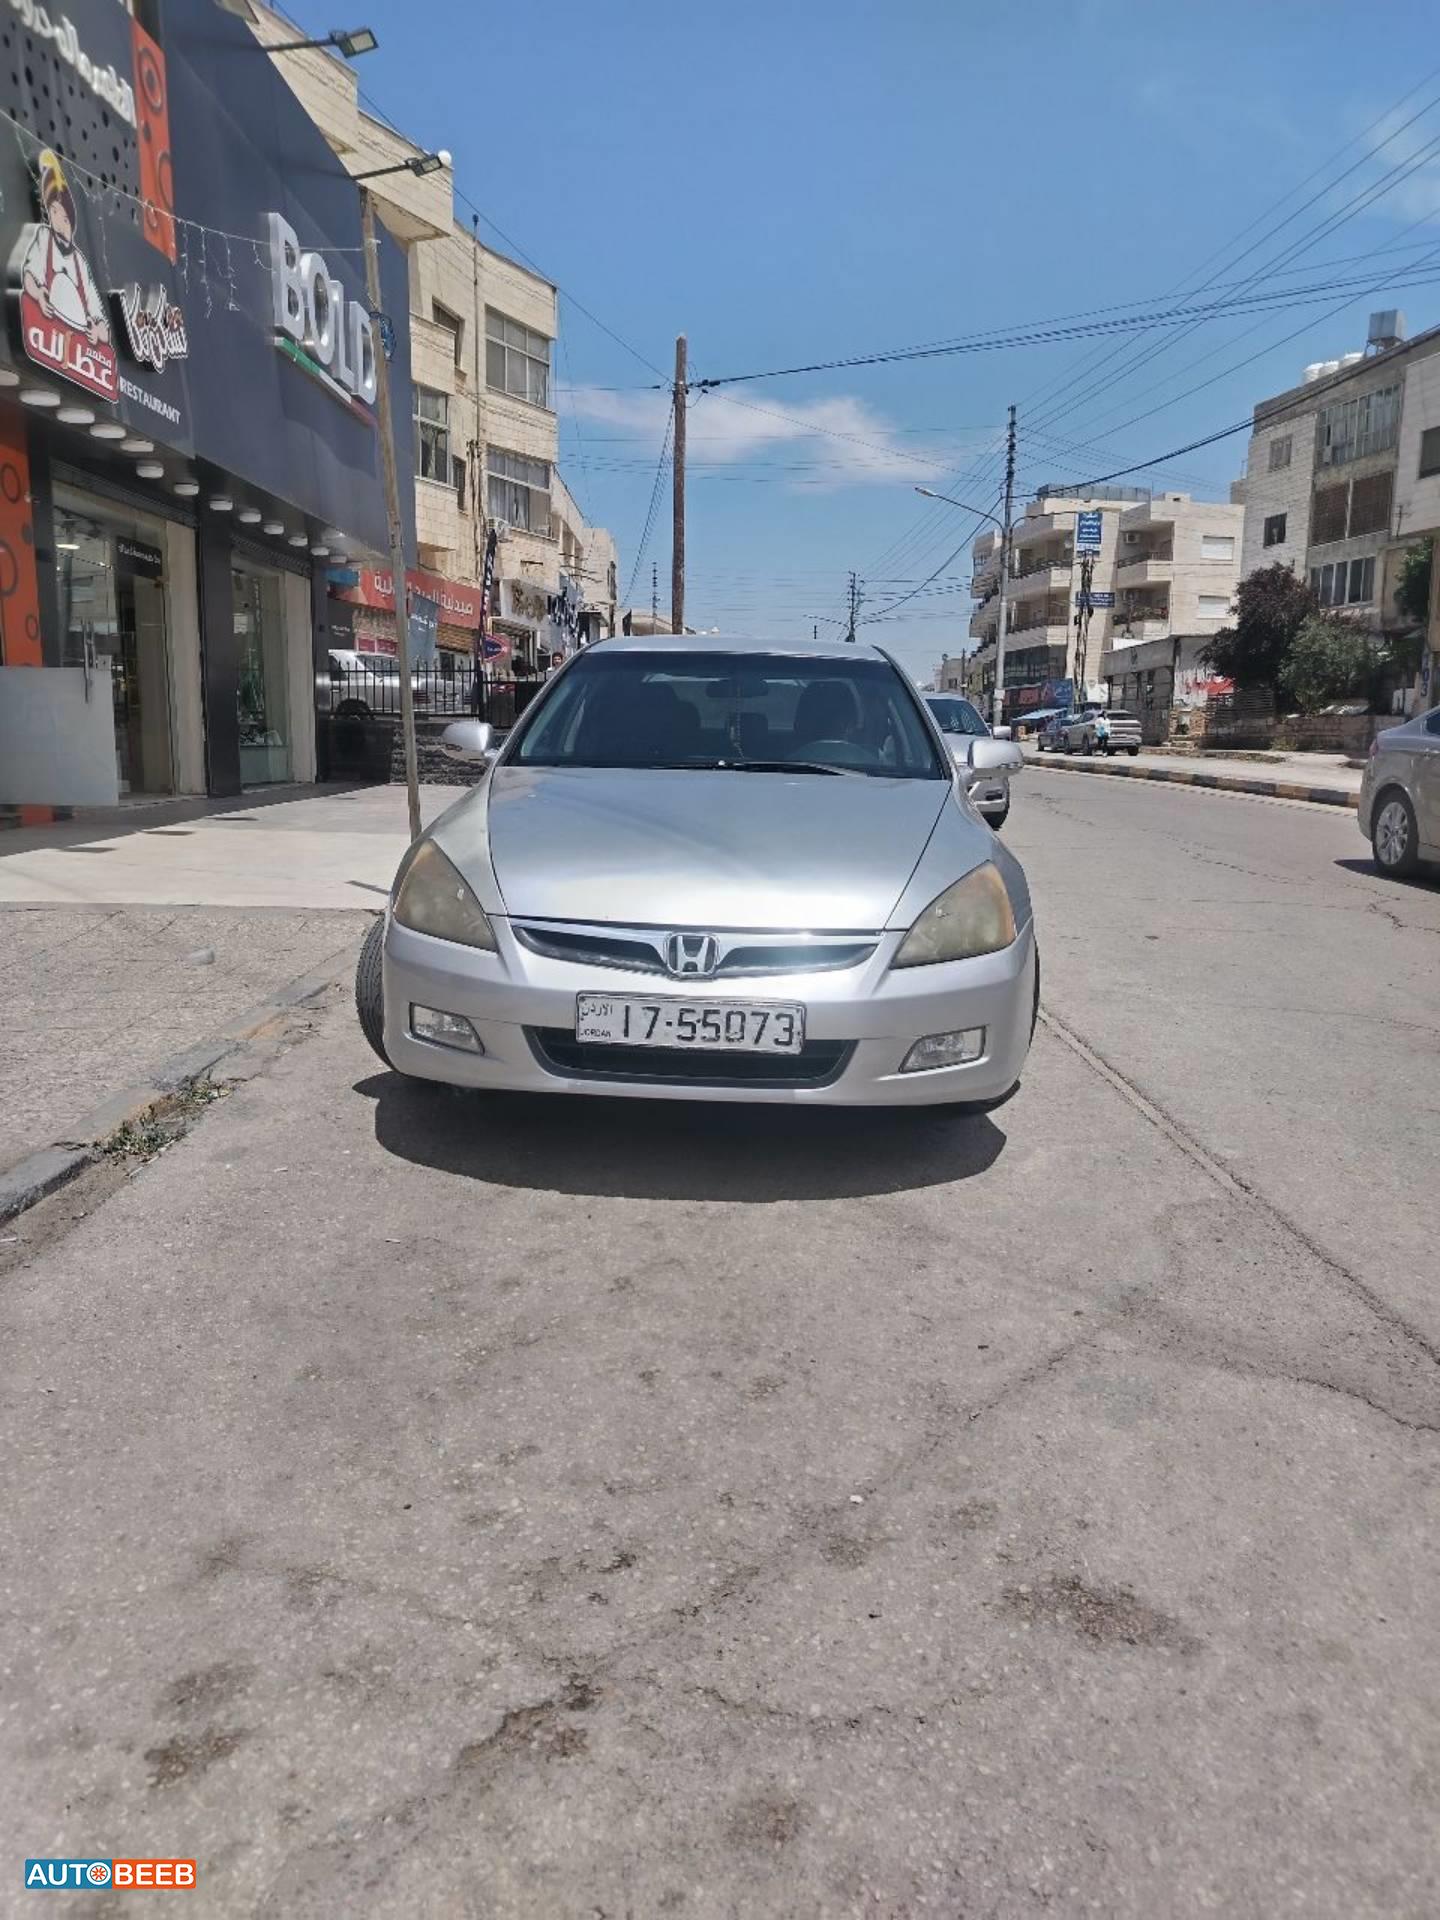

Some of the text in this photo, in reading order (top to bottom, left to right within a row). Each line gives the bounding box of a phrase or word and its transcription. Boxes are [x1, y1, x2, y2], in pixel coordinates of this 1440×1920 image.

[268, 212, 377, 406] BOLD
[119, 375, 181, 424] RESTAURANT
[624, 1004, 795, 1047] 17-55073
